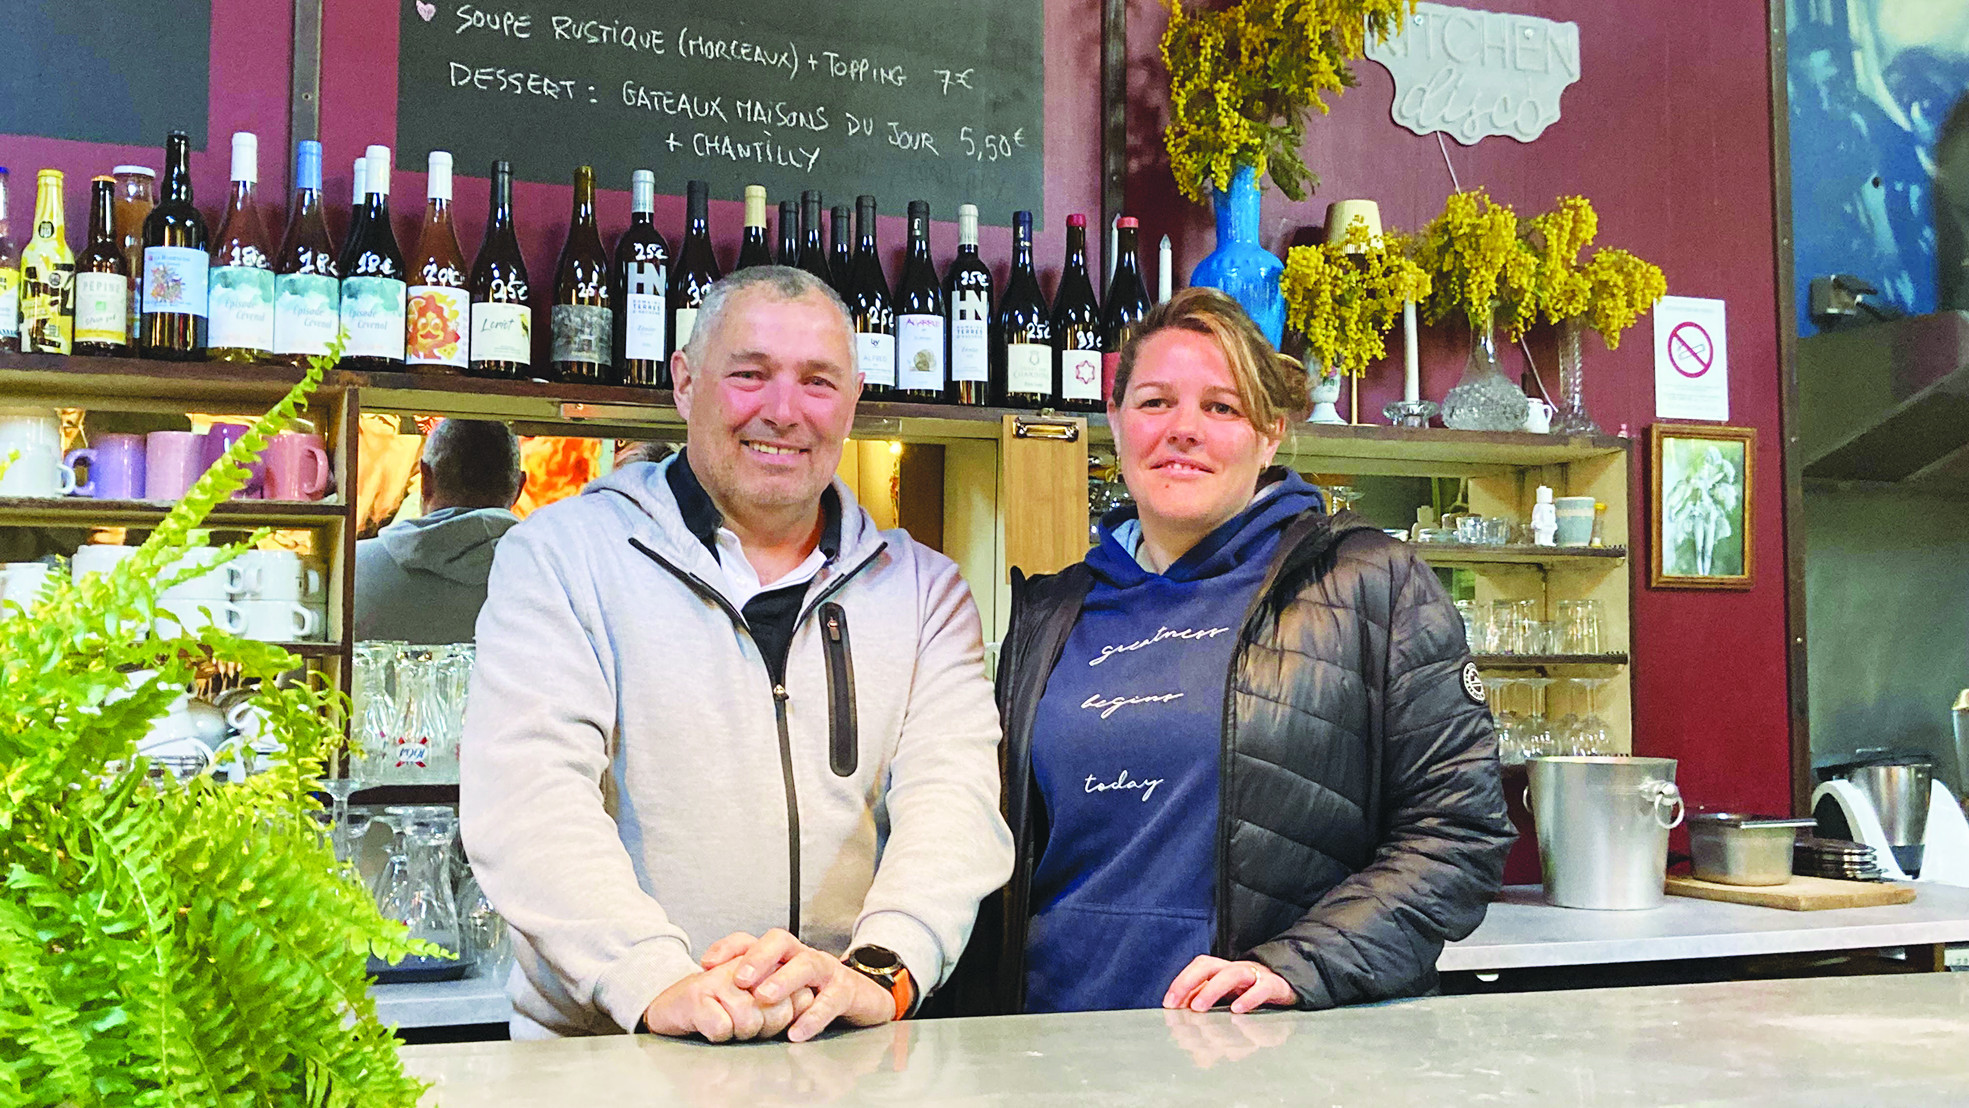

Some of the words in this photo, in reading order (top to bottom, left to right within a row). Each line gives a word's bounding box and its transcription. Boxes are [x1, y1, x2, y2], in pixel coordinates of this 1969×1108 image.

[455, 4, 531, 39] SOUPE
[552, 16, 665, 54] RUSTIQUE
[678, 27, 799, 80] (MORCEAUX)
[822, 51, 907, 86] TOPPING
[933, 68, 974, 95] 7€
[449, 61, 576, 100] DESSERT
[736, 99, 829, 131] MAISONS
[845, 112, 873, 136] DU
[887, 121, 939, 156] JOUR
[959, 126, 1025, 162] 5,50€
[692, 130, 821, 172] CHANTILLY
[628, 261, 667, 297] HN
[951, 289, 988, 321] HN
[1088, 626, 1230, 667] greatness
[1080, 693, 1184, 719] begins
[1084, 769, 1164, 802] today
